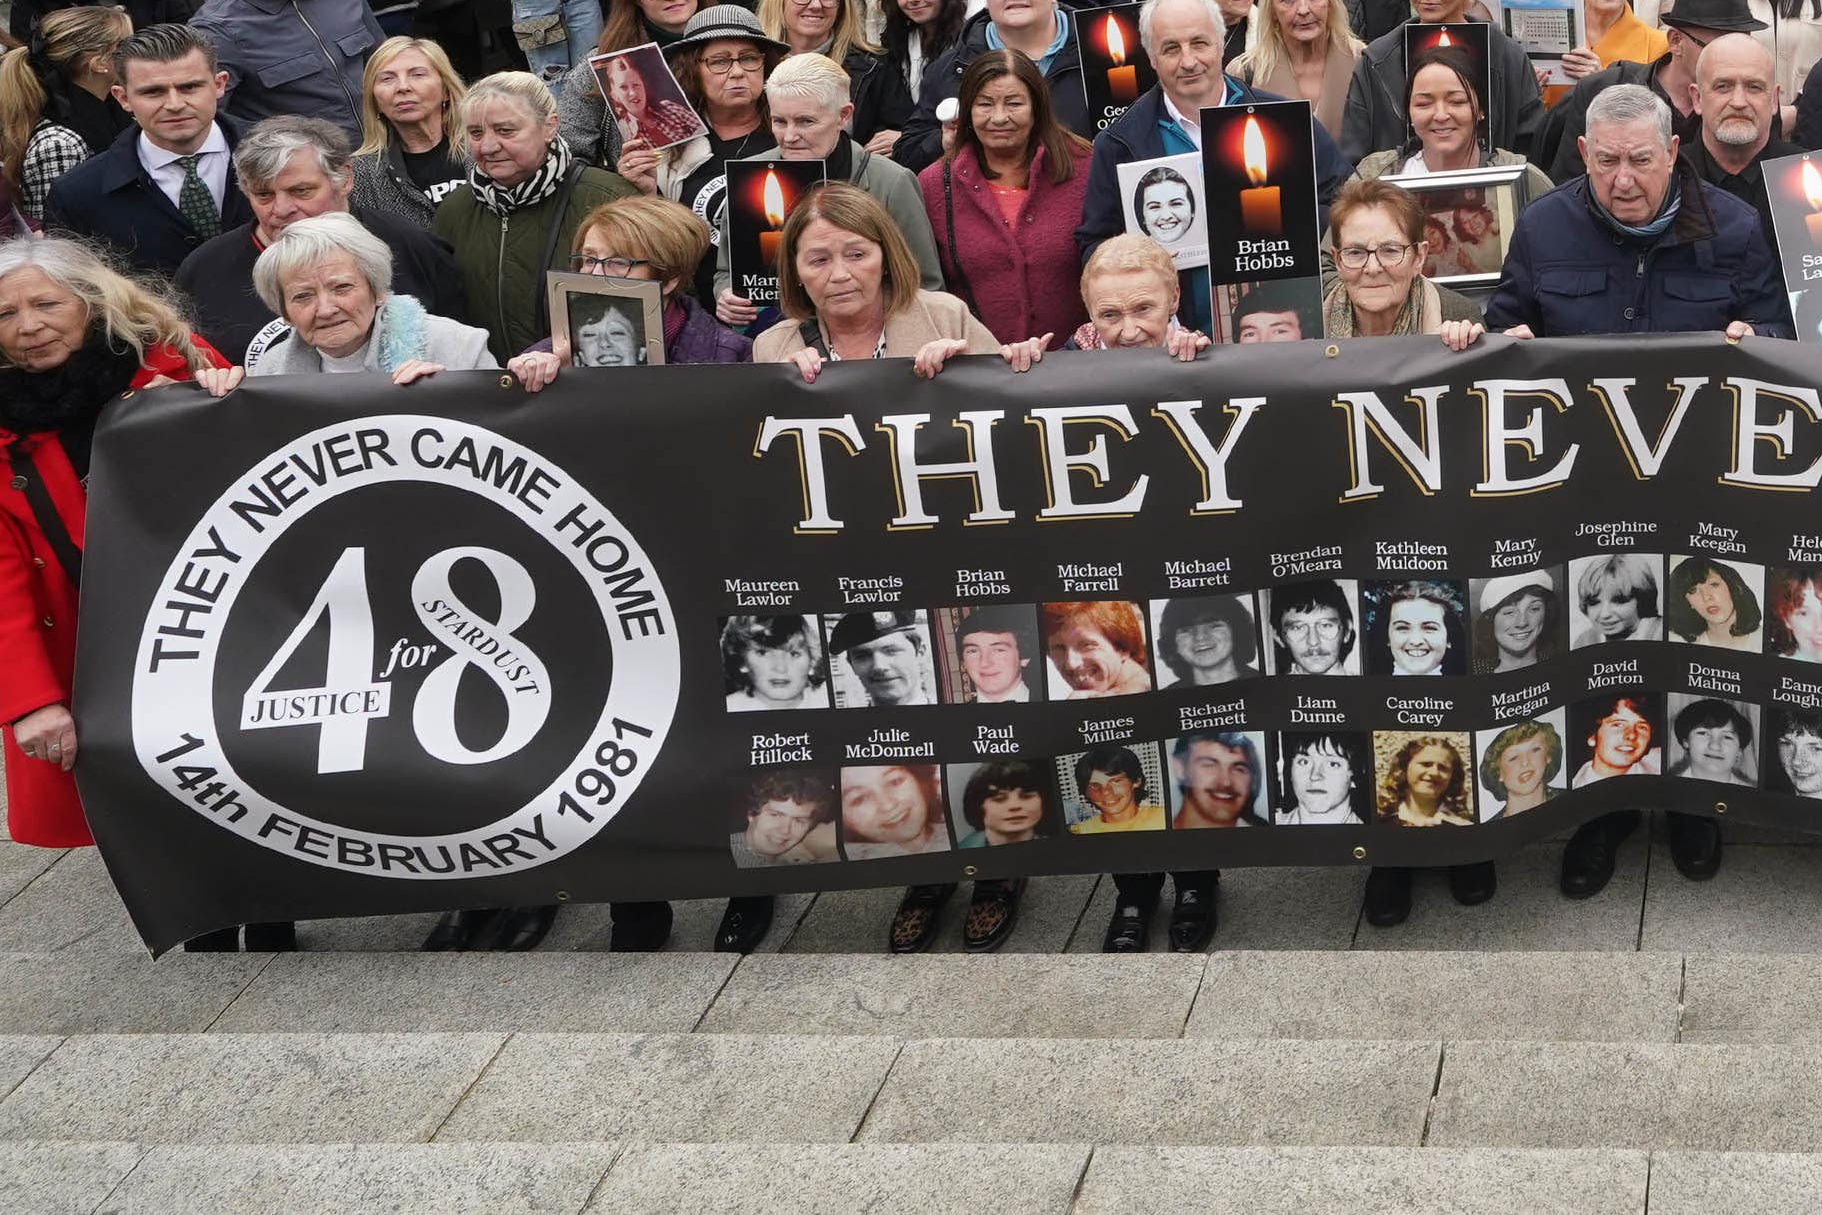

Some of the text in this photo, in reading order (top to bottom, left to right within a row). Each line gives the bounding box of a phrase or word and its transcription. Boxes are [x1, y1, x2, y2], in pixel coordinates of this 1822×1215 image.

[696, 176, 727, 216] HEY NEV
[1238, 239, 1290, 255] Brian
[1235, 253, 1294, 272] Hobbs
[248, 339, 265, 368] THEY
[754, 396, 1268, 536] THEY
[1575, 520, 1657, 539] Josephine
[1597, 531, 1635, 546] Glen
[1698, 522, 1739, 542] Mary
[149, 428, 666, 673] THEY NEVER CAME HOME
[1375, 541, 1448, 556] Kathleen
[1495, 538, 1540, 557] Mary
[1689, 534, 1747, 554] Keegan
[1270, 545, 1343, 567] Brendan
[1376, 555, 1448, 571] Muldoon
[1490, 550, 1542, 568] Kenny
[1057, 562, 1123, 578] Michael
[1164, 557, 1231, 575] Michael
[1270, 555, 1343, 578] O'Meara
[724, 578, 800, 593] Maureen
[838, 575, 904, 590] Francis
[956, 569, 1006, 583] Brian
[1063, 577, 1119, 592] Farrell
[1168, 573, 1230, 589] Barrett
[736, 592, 793, 606] Lawlor
[843, 588, 902, 604] Lawlor
[955, 582, 1011, 597] Hobbs
[422, 598, 541, 697] STARDUST
[380, 638, 437, 677] for
[1587, 668, 1643, 690] Morton
[1593, 659, 1638, 680] David
[1688, 662, 1741, 683] Donna
[1688, 671, 1741, 694] Mahon
[249, 688, 381, 722] JUSTICE
[1297, 695, 1337, 709] Liam
[1386, 696, 1454, 710] Caroline
[1491, 682, 1551, 710] Martina
[1179, 698, 1247, 722] Richard
[1290, 709, 1345, 723] Dunne
[1491, 690, 1552, 724] Keegan
[1078, 717, 1135, 737] James
[1179, 709, 1247, 731] Bennett
[1397, 710, 1444, 727] Carey
[867, 728, 910, 743] Julie
[977, 724, 1014, 740] Paul
[1083, 723, 1134, 744] Millar
[751, 732, 812, 752] Robert
[845, 741, 935, 759] McDonnell
[972, 739, 1020, 754] Wade
[750, 746, 813, 766] Hillock
[155, 716, 654, 874] 14th FEBRUARY 1981
